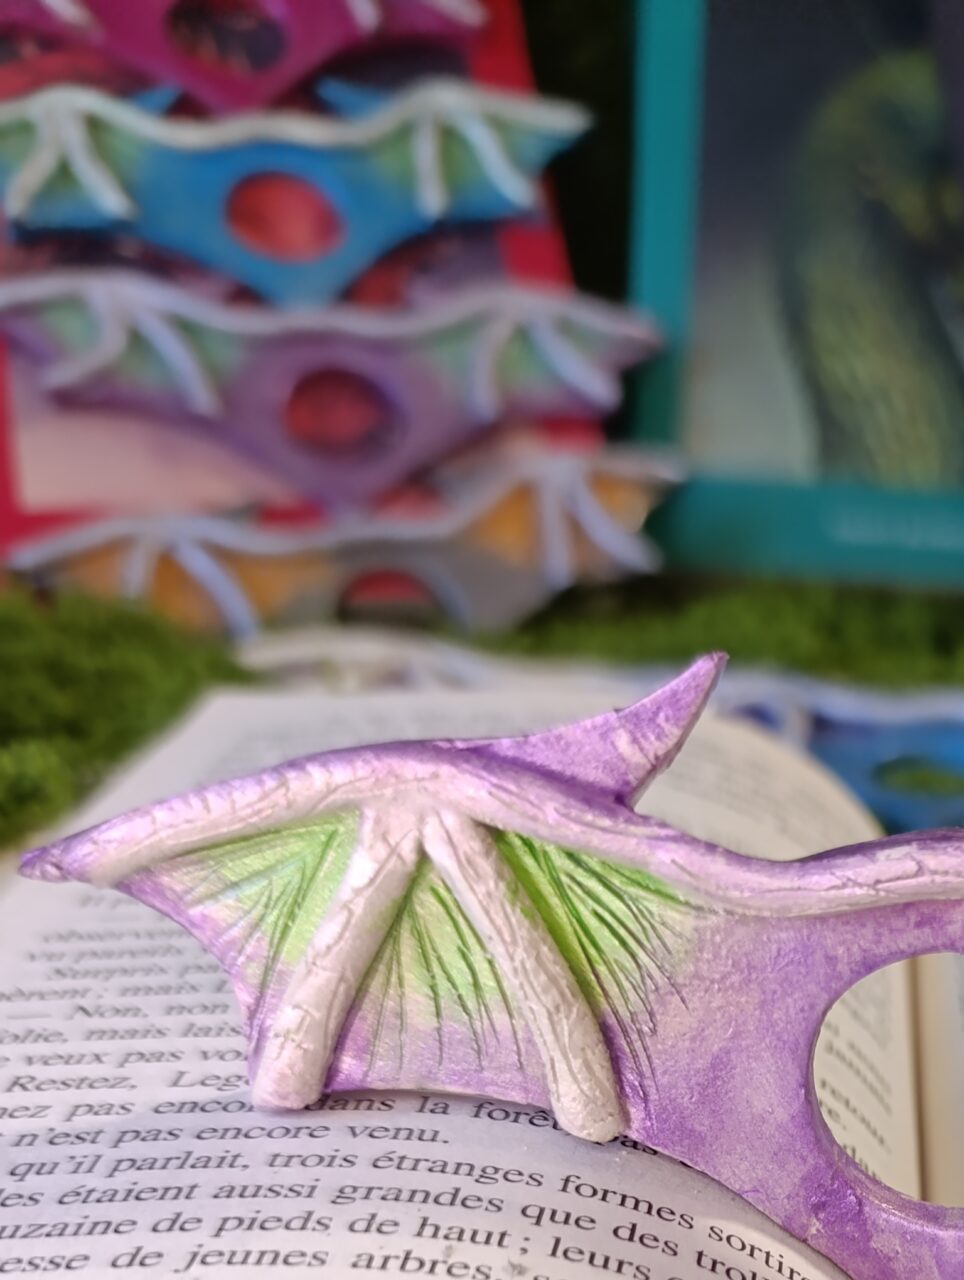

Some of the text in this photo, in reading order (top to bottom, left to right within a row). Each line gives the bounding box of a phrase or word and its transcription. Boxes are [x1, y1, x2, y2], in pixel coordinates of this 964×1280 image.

[65, 1003, 230, 1021] Non, non
[83, 1023, 170, 1042] mais
[23, 1049, 186, 1068] veux pas
[5, 1074, 138, 1094] Restez,
[63, 1100, 136, 1122] pas
[415, 1095, 450, 1116] la
[11, 1124, 450, 1149] n'est pas encore venu.
[8, 1153, 104, 1183] qu'il
[105, 1150, 250, 1179] parlait,
[267, 1150, 359, 1168] trois
[372, 1151, 545, 1185] étranges
[557, 1174, 695, 1231] formes
[57, 1181, 201, 1206] étaient
[212, 1177, 321, 1201] aussi
[330, 1182, 506, 1214] grandes
[520, 1201, 598, 1232] que
[612, 1220, 680, 1258] des
[151, 1211, 203, 1234] de
[209, 1210, 334, 1239] pieds
[346, 1211, 401, 1235] de
[412, 1215, 514, 1249] haut
[110, 1245, 165, 1269] de
[172, 1243, 329, 1274] jeunes
